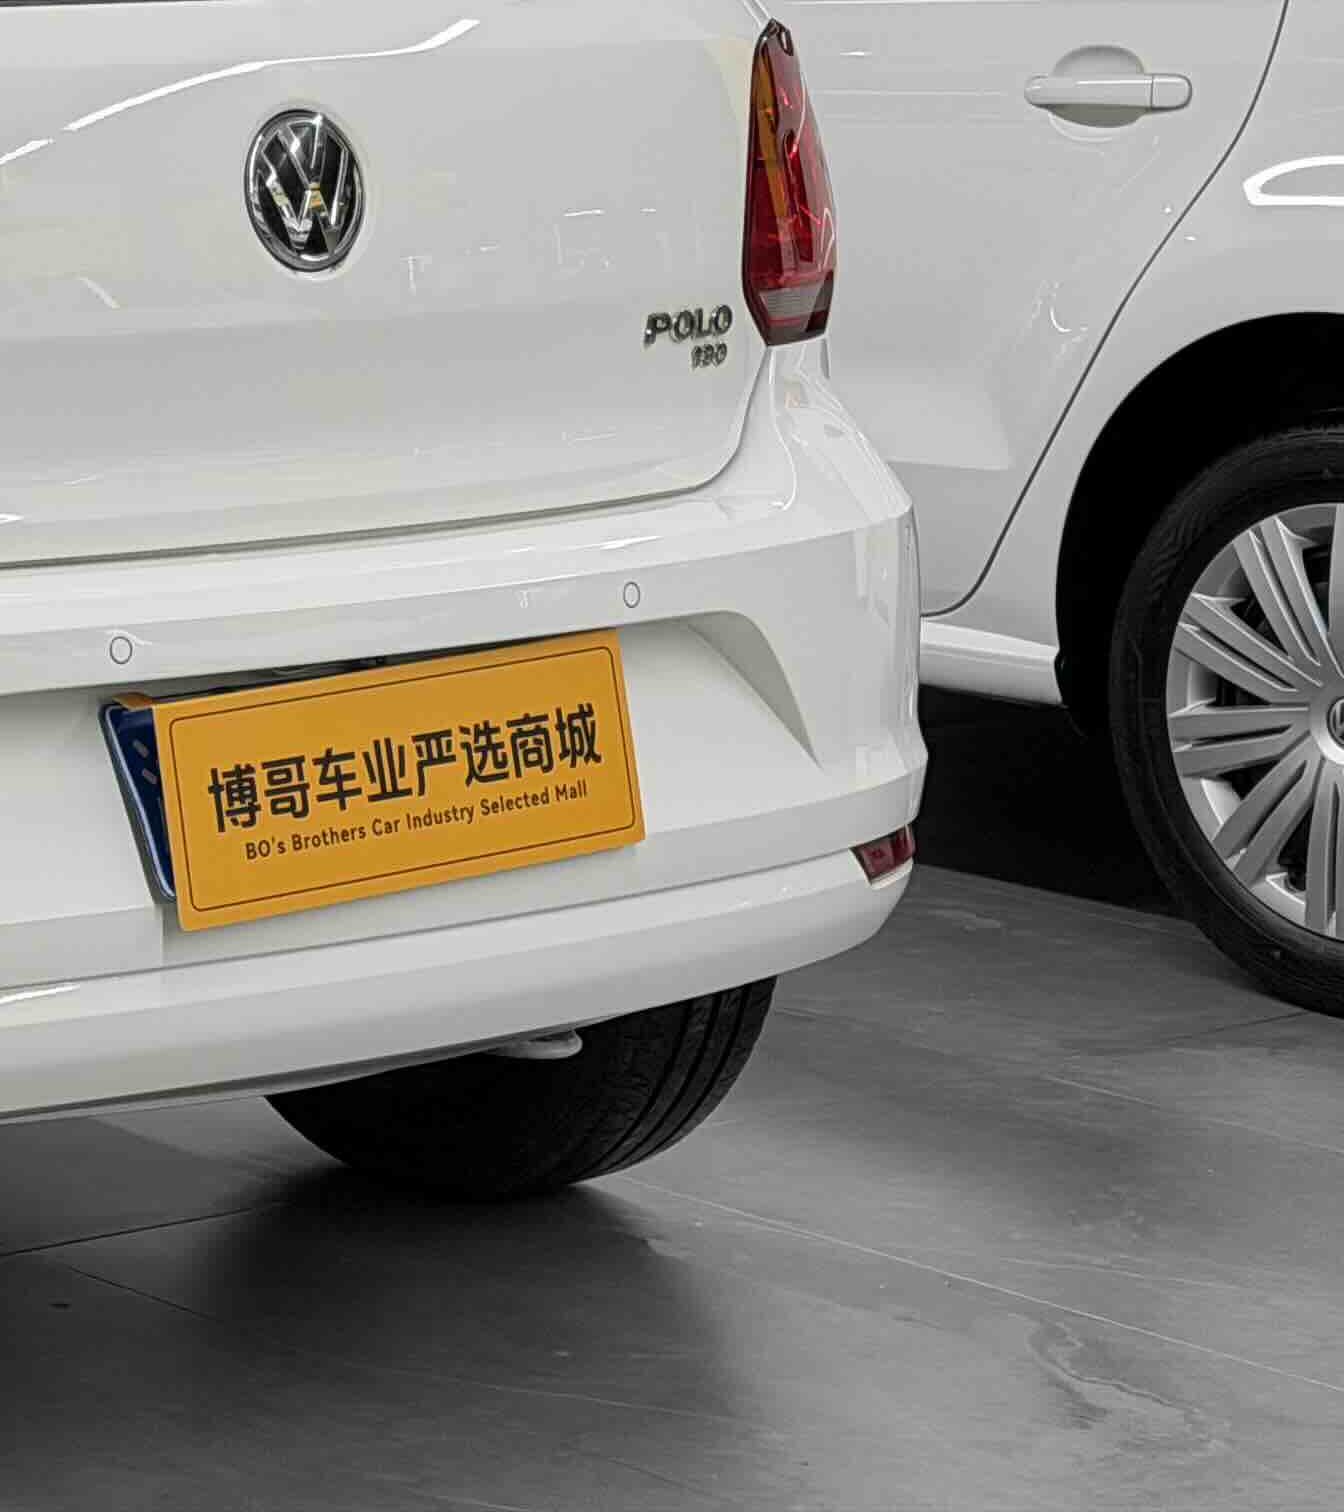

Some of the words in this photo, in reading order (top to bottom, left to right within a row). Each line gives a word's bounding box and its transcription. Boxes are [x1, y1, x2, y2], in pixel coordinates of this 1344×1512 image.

[643, 304, 733, 348] POLO
[208, 703, 603, 833] 博哥车业严选商城
[245, 838, 286, 860] BO's
[291, 823, 367, 853] Brothers
[372, 817, 401, 837] Car
[406, 803, 475, 830] Industry
[480, 791, 551, 817] Selected
[555, 779, 588, 802] Mall
